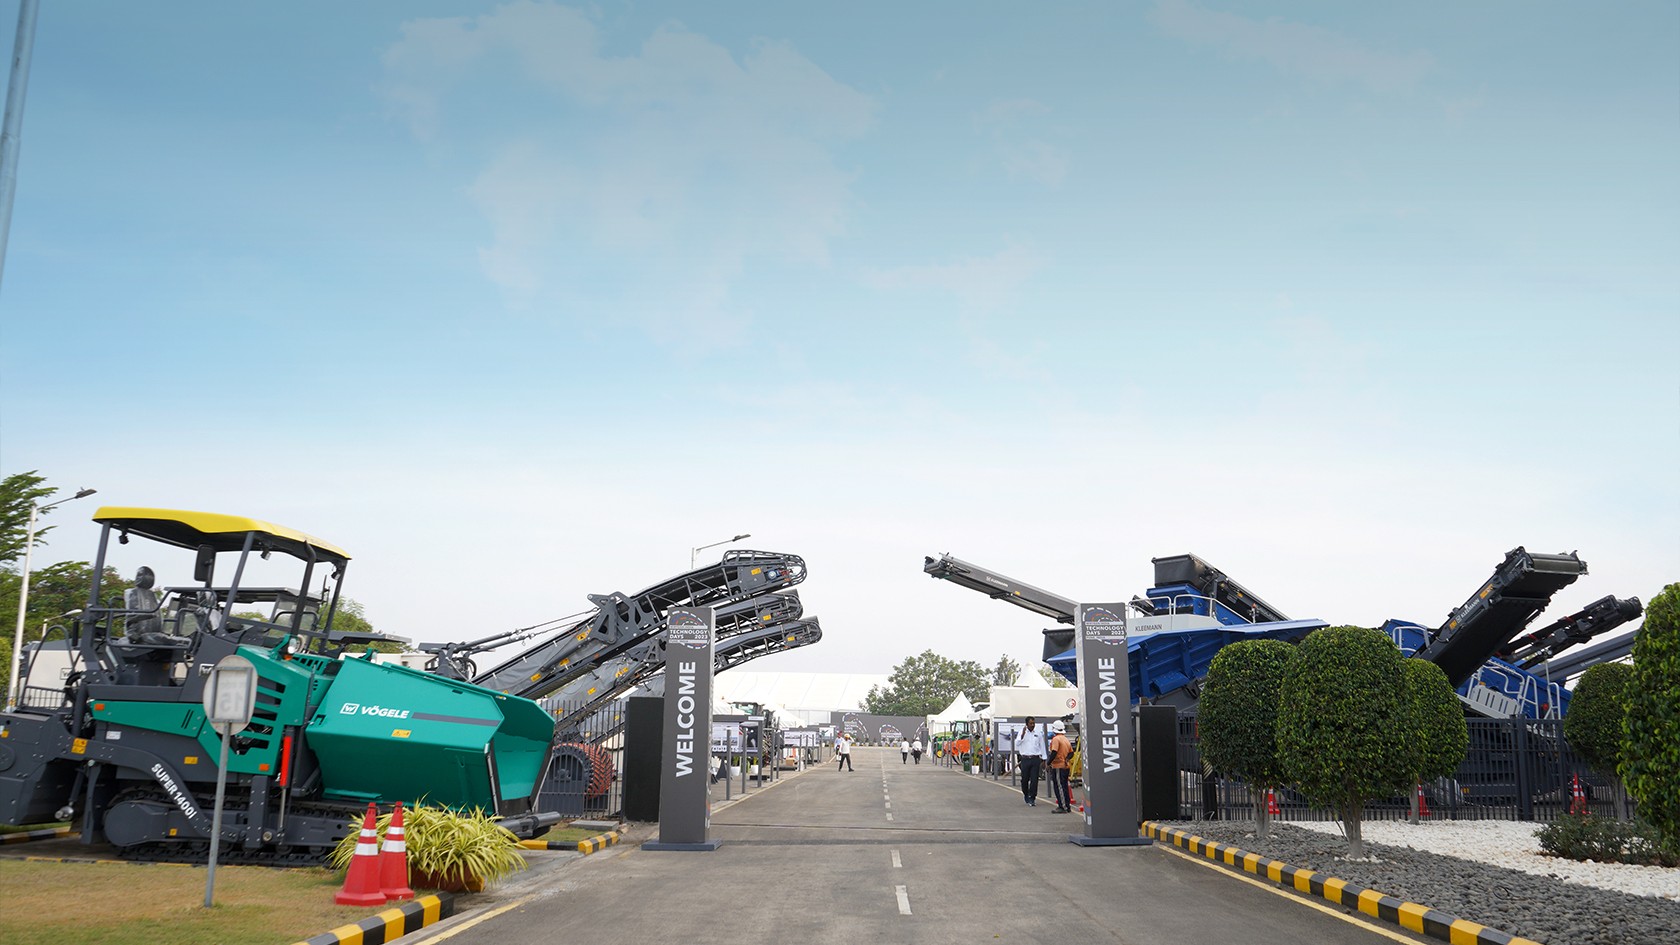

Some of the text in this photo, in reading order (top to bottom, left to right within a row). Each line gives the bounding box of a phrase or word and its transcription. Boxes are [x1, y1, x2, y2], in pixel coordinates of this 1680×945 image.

[1134, 624, 1163, 632] KLEEMANN
[361, 705, 410, 719] VÖGELE
[675, 661, 696, 777] WELCOME
[1098, 657, 1121, 773] WELCOME
[151, 763, 178, 795] SUPER
